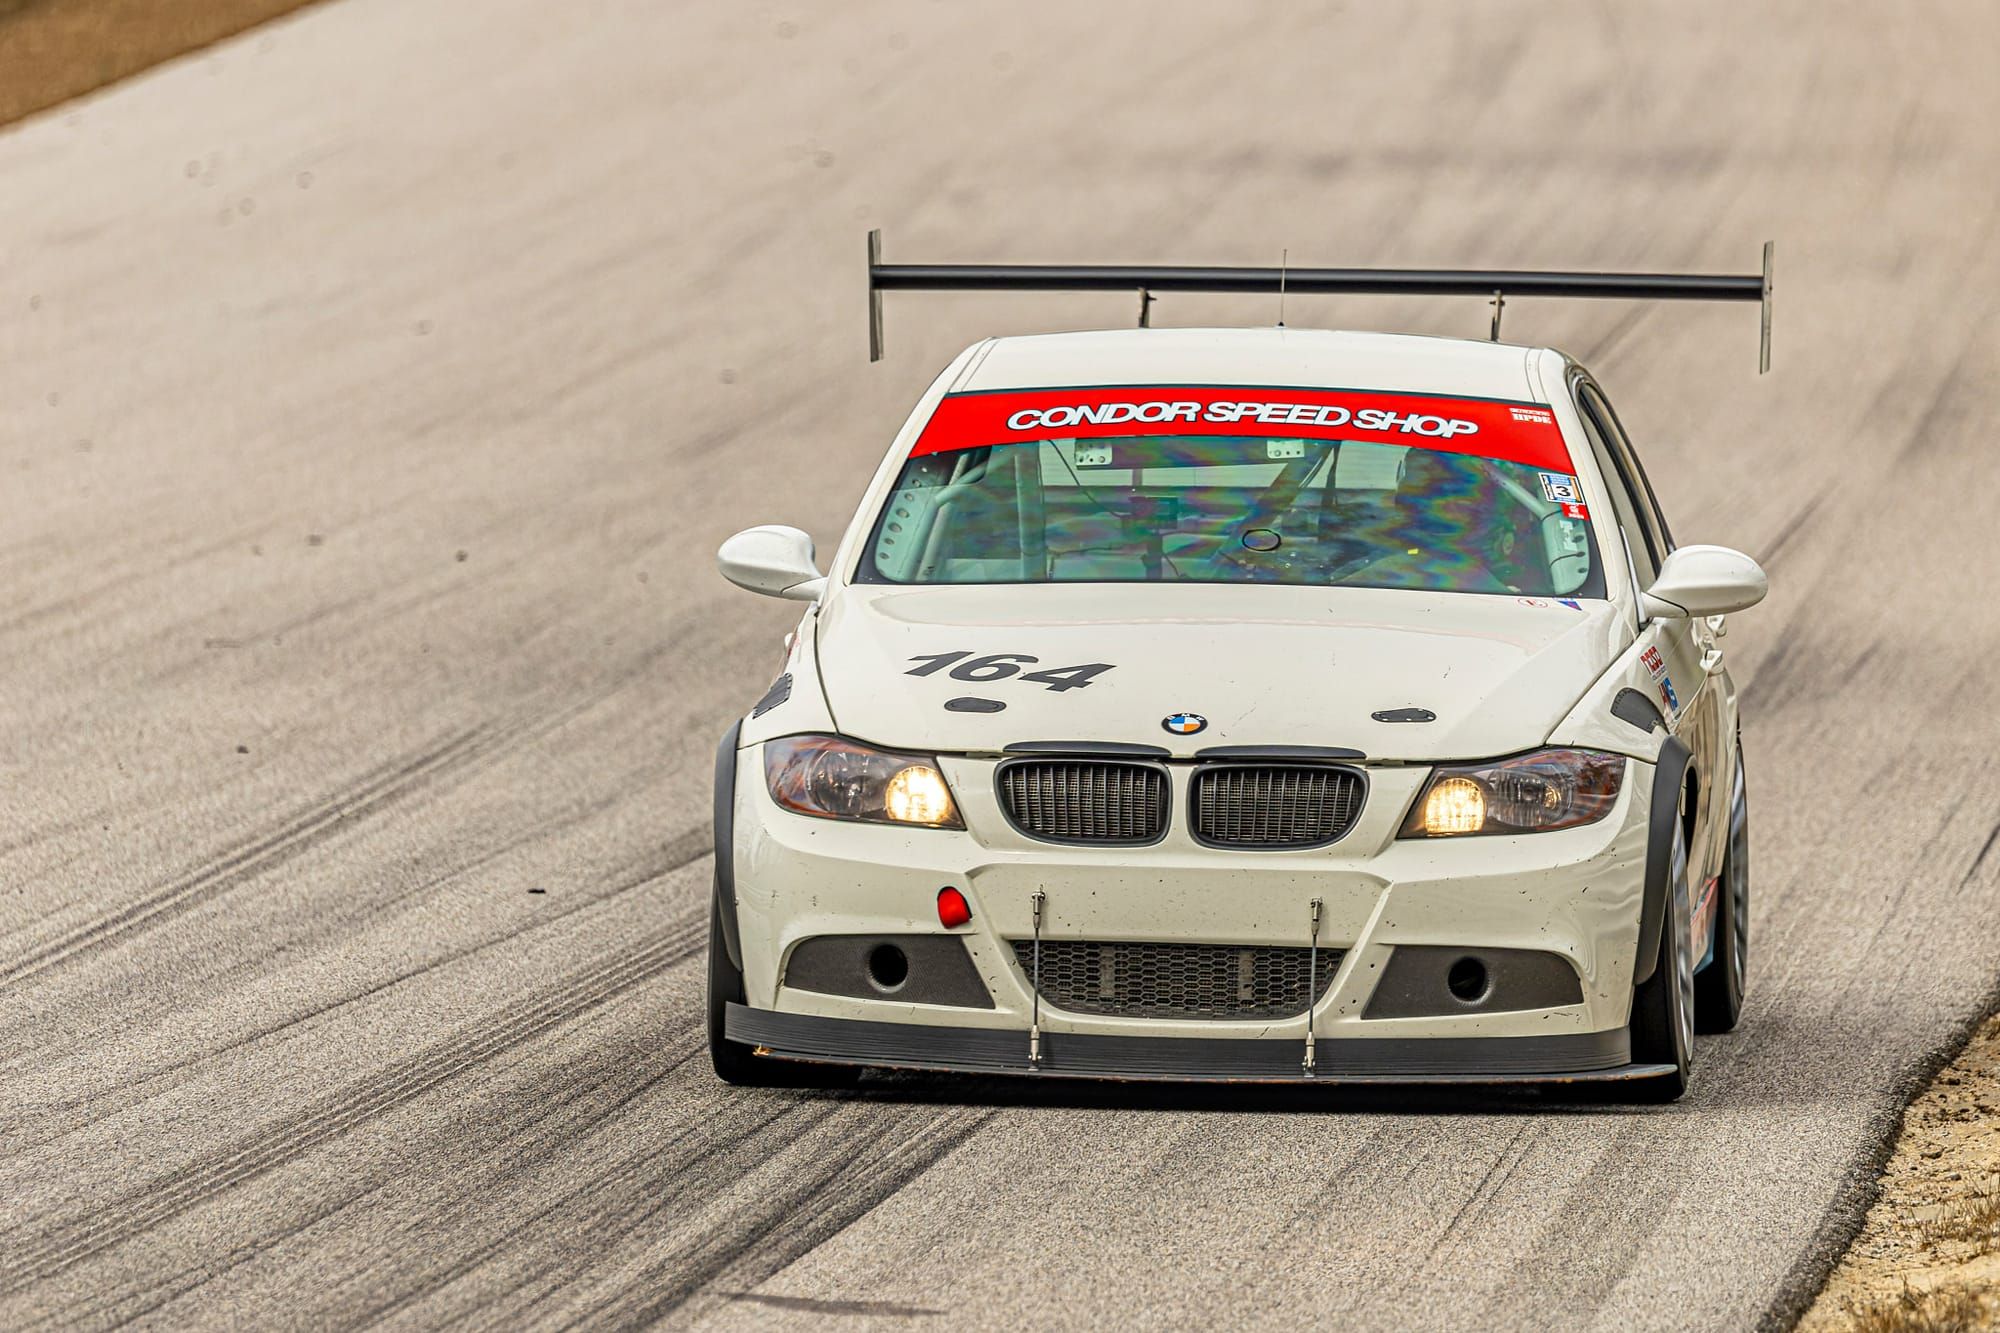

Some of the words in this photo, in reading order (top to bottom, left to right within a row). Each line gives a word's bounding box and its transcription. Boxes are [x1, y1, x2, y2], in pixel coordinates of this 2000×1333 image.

[1006, 401, 1201, 432] CONDOR
[1203, 401, 1350, 428] SPEED
[1351, 408, 1480, 440] SHOP
[1555, 485, 1571, 497] 3
[903, 650, 1117, 692] 164
